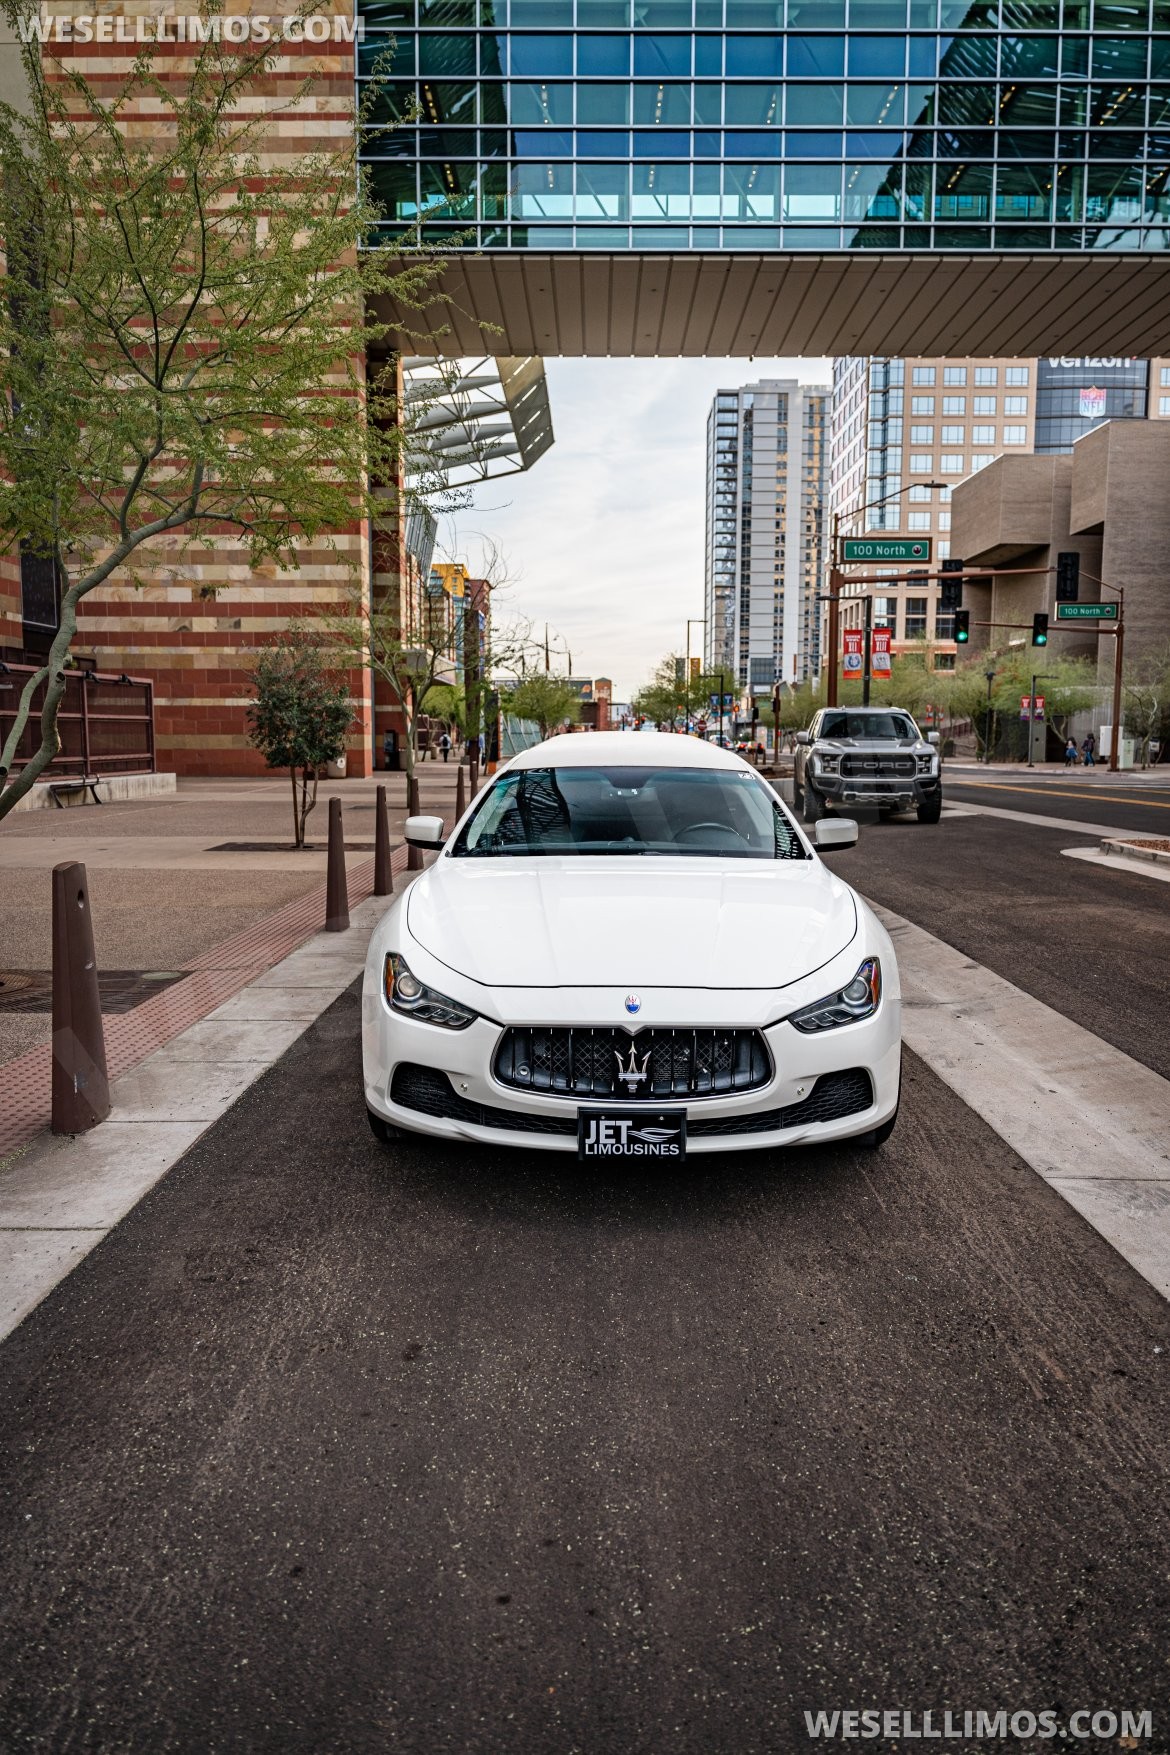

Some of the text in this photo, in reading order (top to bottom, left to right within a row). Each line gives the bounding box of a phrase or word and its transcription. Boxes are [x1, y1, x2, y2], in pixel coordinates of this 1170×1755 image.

[1082, 400, 1103, 413] NFL
[853, 545, 906, 556] 100 North
[1064, 607, 1101, 615] 100 North
[847, 761, 913, 769] FORD
[585, 1120, 633, 1145] JET
[585, 1144, 680, 1155] LIMOUSINES
